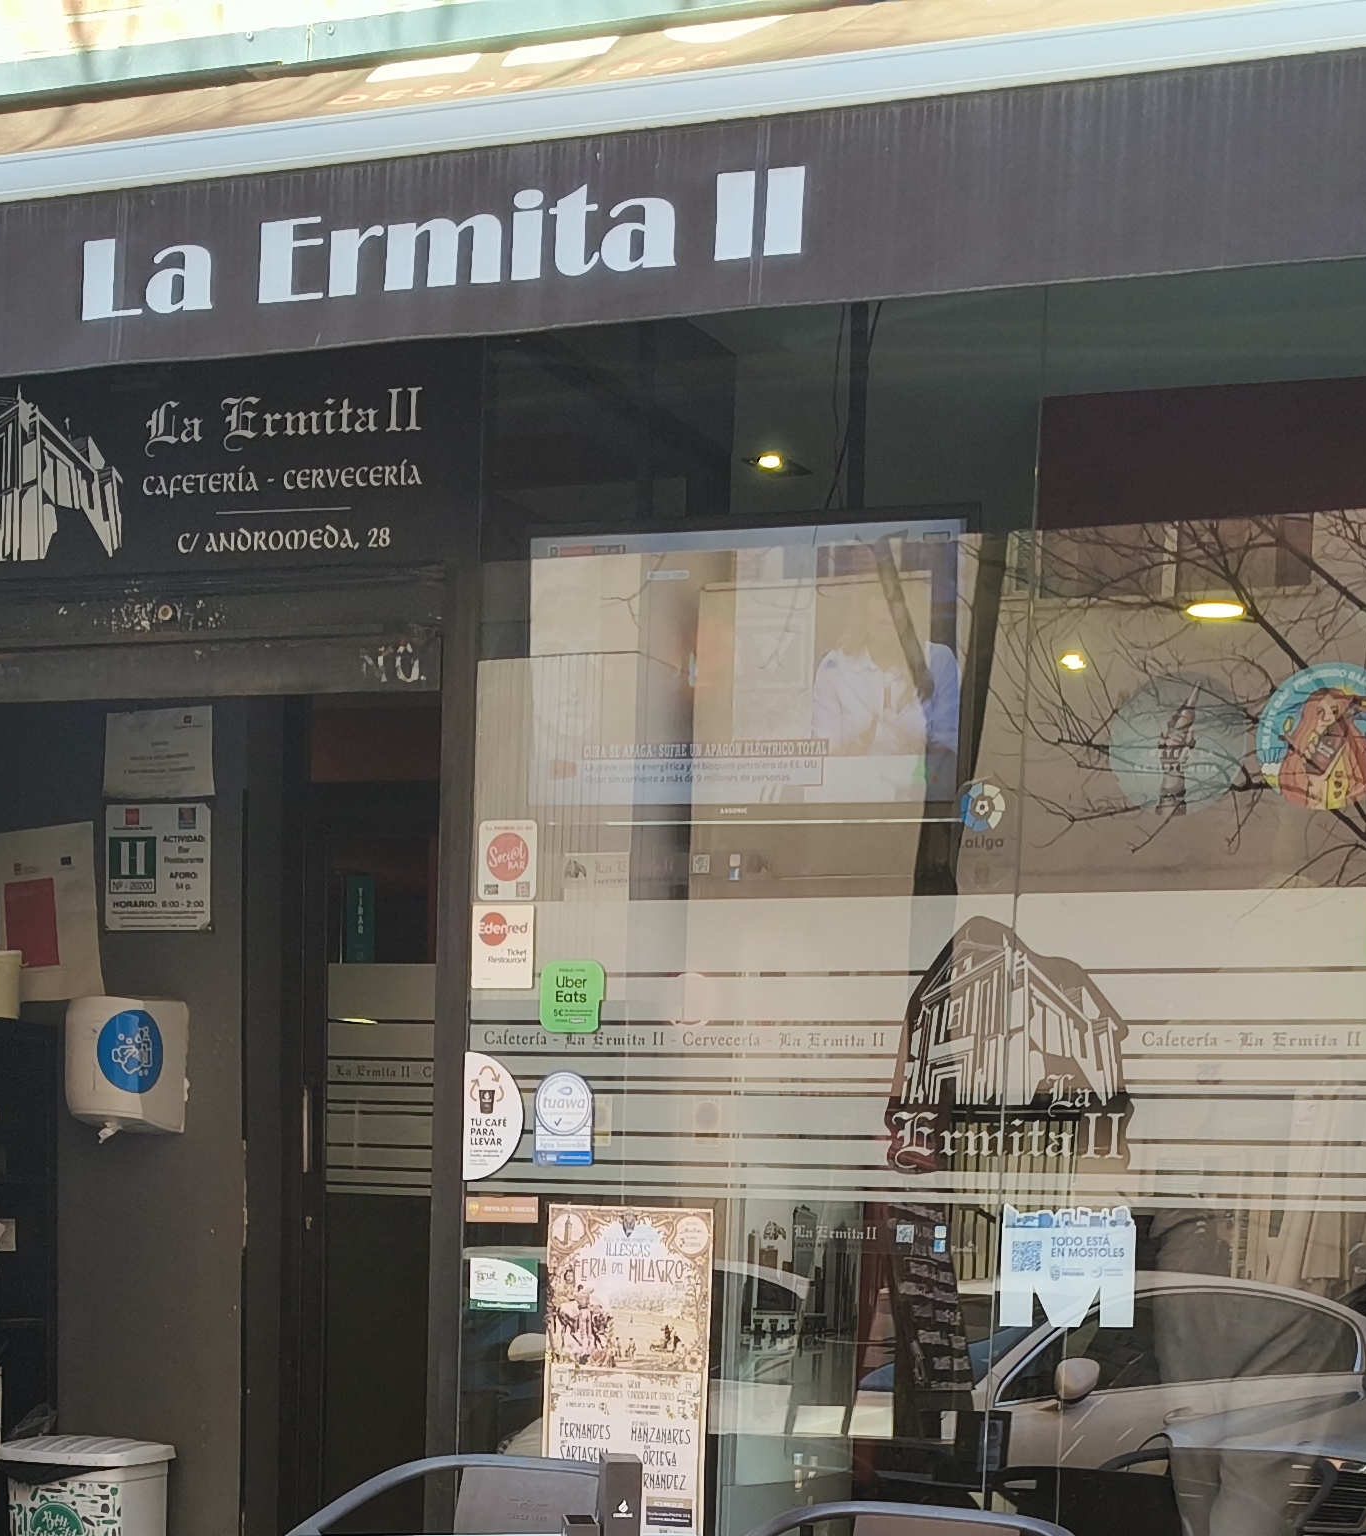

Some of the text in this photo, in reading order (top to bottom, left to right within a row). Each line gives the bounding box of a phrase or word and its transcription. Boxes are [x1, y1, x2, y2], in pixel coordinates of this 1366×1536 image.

[80, 165, 807, 321] La Ermita II
[144, 386, 423, 459] La Ermita II
[141, 459, 423, 499] CAFETERÍA CERVECERÍA
[176, 524, 392, 555] C/ ANDROMEDA, 28
[658, 744, 686, 757] SUFRE
[798, 742, 827, 754] TOTAL
[480, 922, 528, 935] Edenred
[556, 975, 587, 988] Uber
[555, 990, 587, 1003] Eats
[484, 1030, 547, 1047] Cafetería
[593, 1031, 646, 1049] Ermita
[652, 1031, 665, 1046] II
[682, 1031, 761, 1048] Cervecería
[871, 1032, 885, 1047] II
[1140, 1030, 1218, 1048] Cafetería
[1272, 1031, 1338, 1049] Ermita
[1346, 1031, 1361, 1048] II
[542, 1097, 586, 1109] tuawa
[1048, 1075, 1093, 1117] La
[470, 1116, 507, 1127] TU CAFÉ
[470, 1128, 495, 1136] PARA
[891, 1112, 1125, 1168] Ermita II
[470, 1137, 502, 1146] LLEVAR
[794, 1225, 877, 1240] La Ermita II
[1051, 1233, 1110, 1246] TODO ESTÁ
[606, 1243, 650, 1257] ILLESCAS
[1051, 1245, 1124, 1257] EN MÓSTOLES
[629, 1260, 683, 1284] MILAGRO
[560, 1422, 610, 1440] FERNANDES
[631, 1427, 691, 1445] MANZANARES
[643, 1450, 677, 1467] ORTEGA
[643, 1470, 686, 1490] RNÁNDEZ
